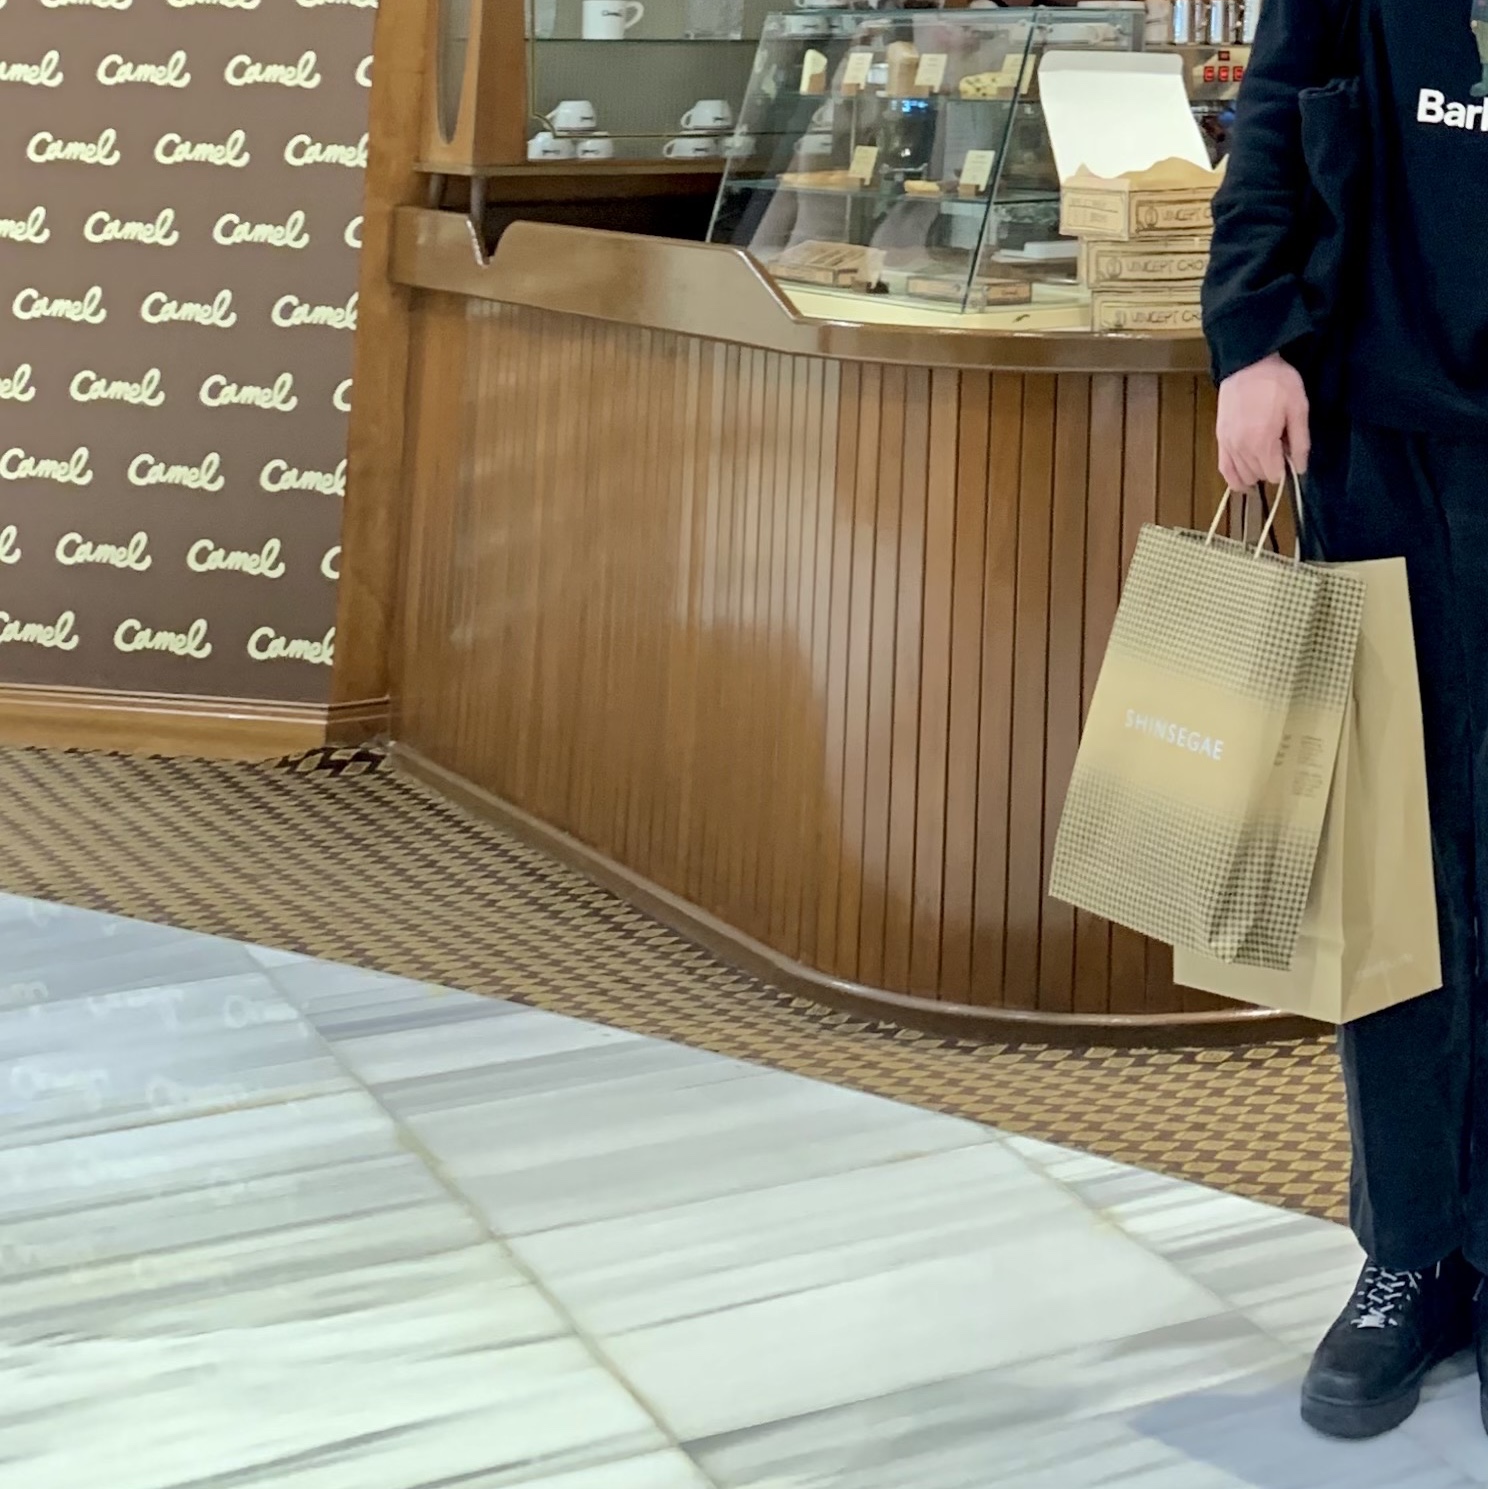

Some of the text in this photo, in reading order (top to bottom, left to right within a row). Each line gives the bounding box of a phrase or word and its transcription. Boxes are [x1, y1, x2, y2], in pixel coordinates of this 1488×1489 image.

[96, 50, 191, 88] Camel
[224, 51, 321, 88] Camel
[27, 128, 120, 165] Camel
[154, 130, 250, 167] Camel
[84, 208, 179, 246] Camel
[213, 210, 309, 248] Camel
[12, 286, 107, 324] Camel
[141, 289, 237, 327] Camel
[69, 368, 165, 406] Camel
[199, 373, 298, 411] Camel
[0, 447, 93, 485] Camel
[128, 452, 224, 491] Camel
[55, 532, 152, 571] Camel
[187, 538, 285, 578] Camel
[114, 619, 212, 658] Camel
[1124, 708, 1224, 761] SHINSEGAE
